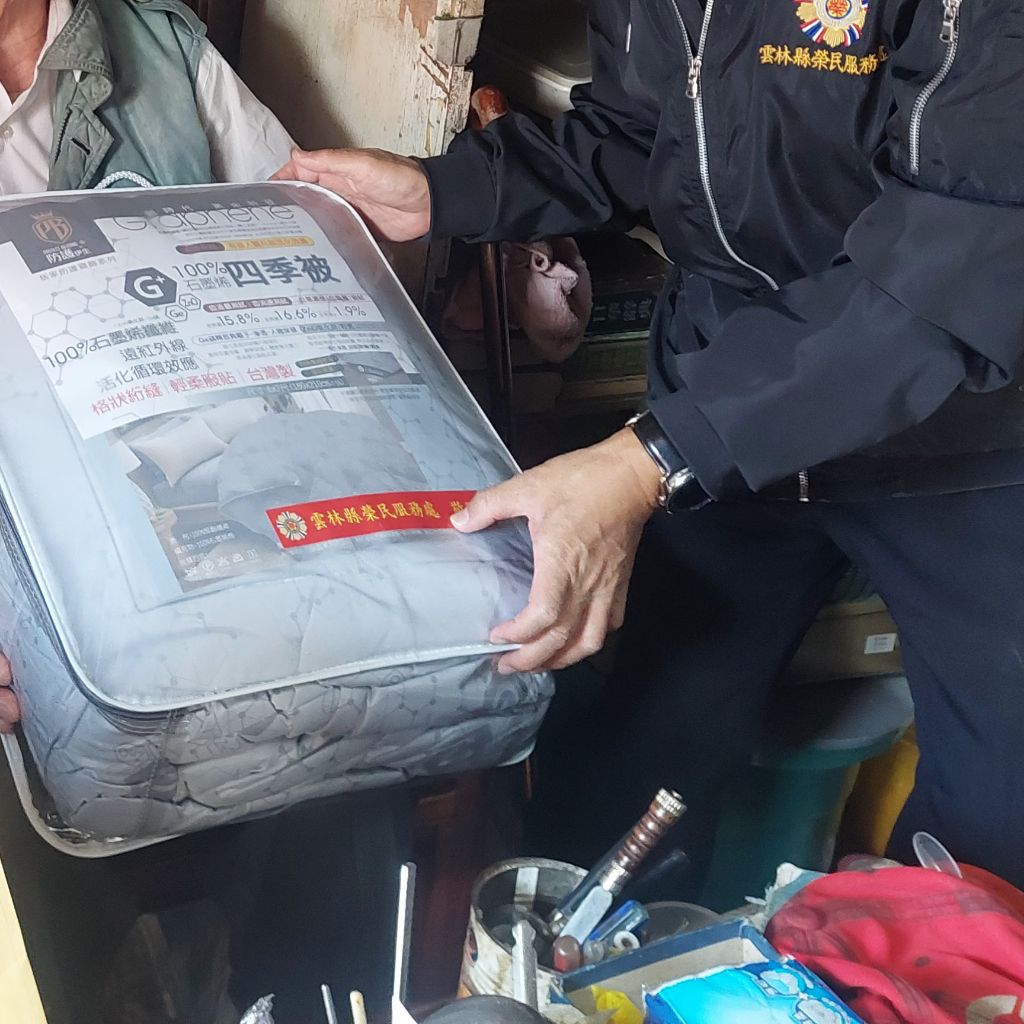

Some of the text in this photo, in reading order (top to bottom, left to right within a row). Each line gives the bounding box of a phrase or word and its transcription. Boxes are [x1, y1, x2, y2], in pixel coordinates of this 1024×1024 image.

[172, 260, 227, 278] 100%
[223, 252, 341, 288] 四季被
[310, 499, 442, 531] 雲林縣榮民服務處
